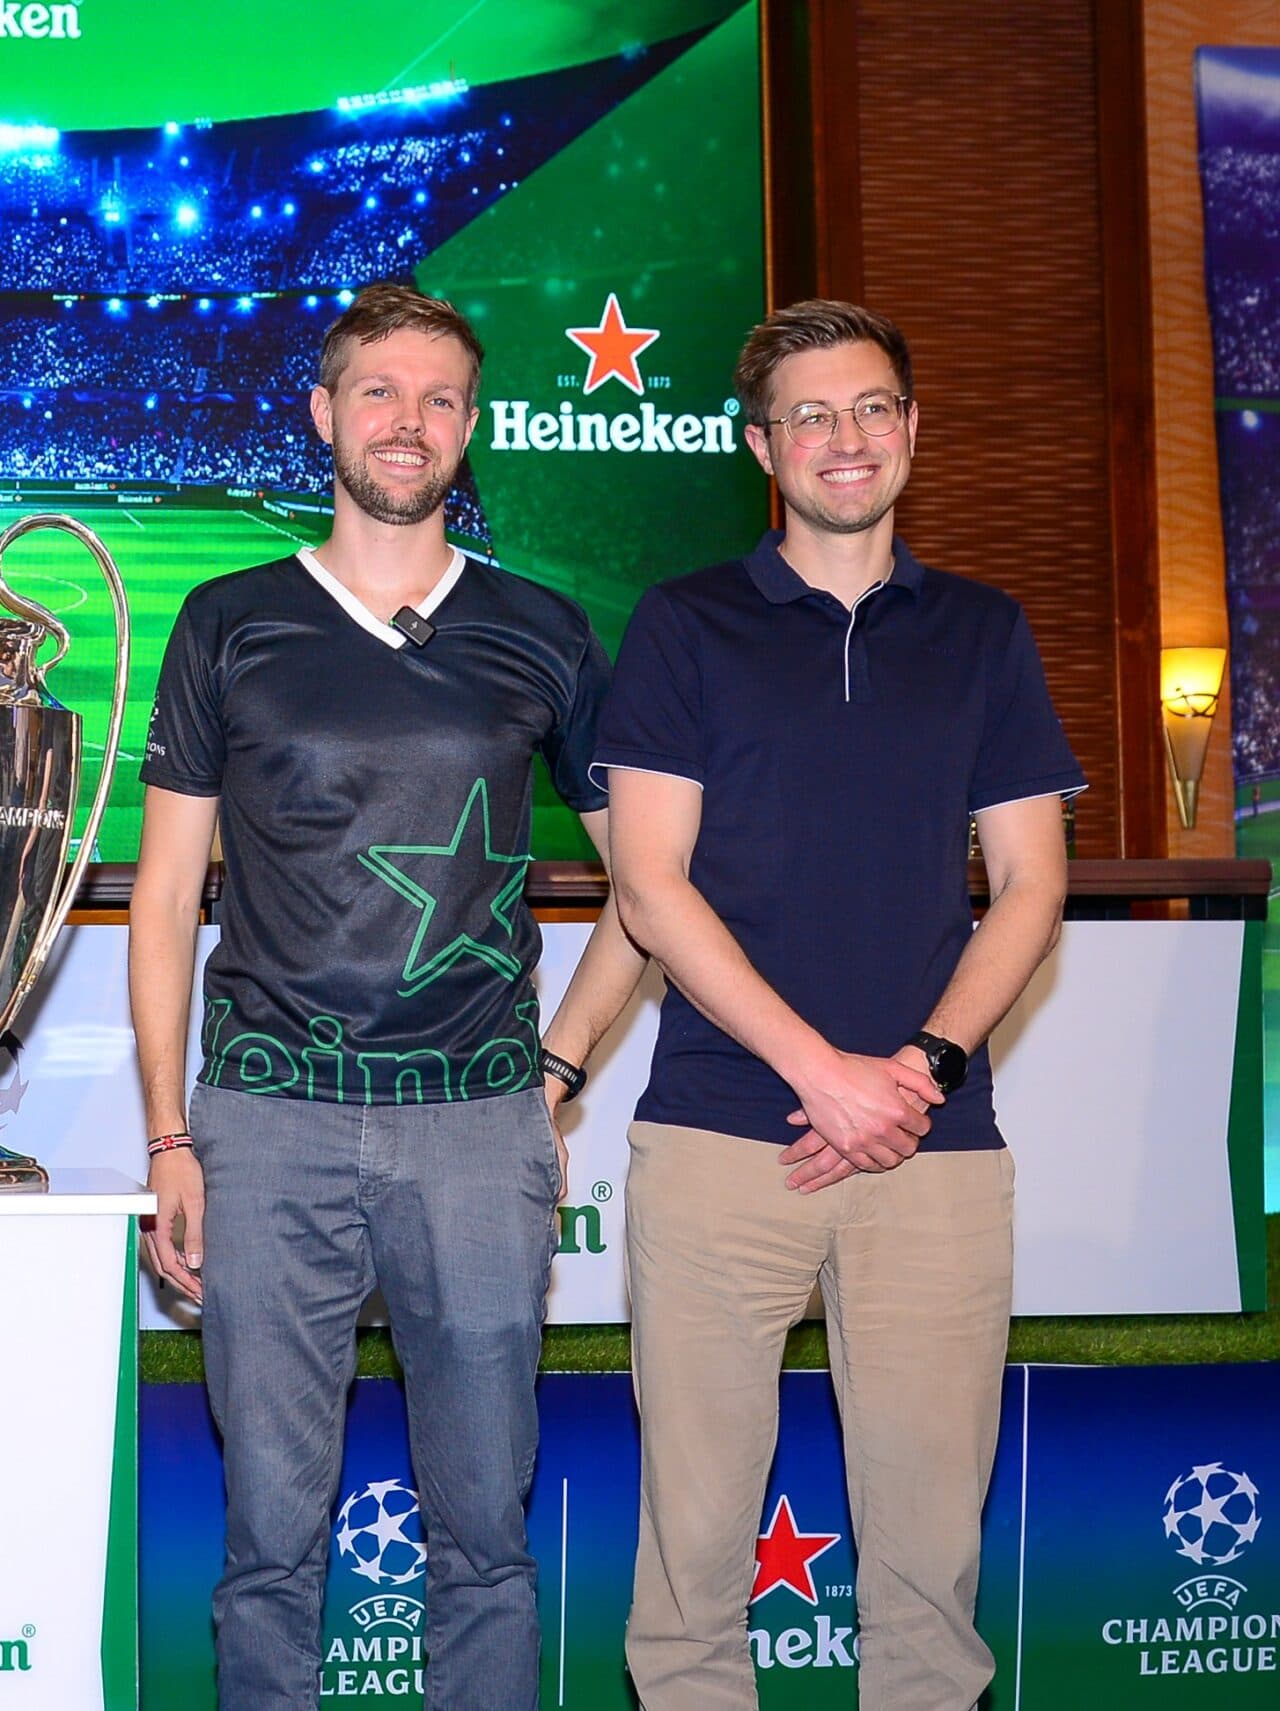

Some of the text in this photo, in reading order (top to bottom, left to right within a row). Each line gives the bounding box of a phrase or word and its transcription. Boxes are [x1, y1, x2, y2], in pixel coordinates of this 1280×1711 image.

[825, 1585, 853, 1597] 1873
[1176, 1580, 1241, 1606] UEFA
[352, 1600, 421, 1626] UEFA
[1102, 1614, 1280, 1645] CHAMPIO
[1140, 1647, 1277, 1675] LEAGUE
[320, 1669, 425, 1695] LEAG
